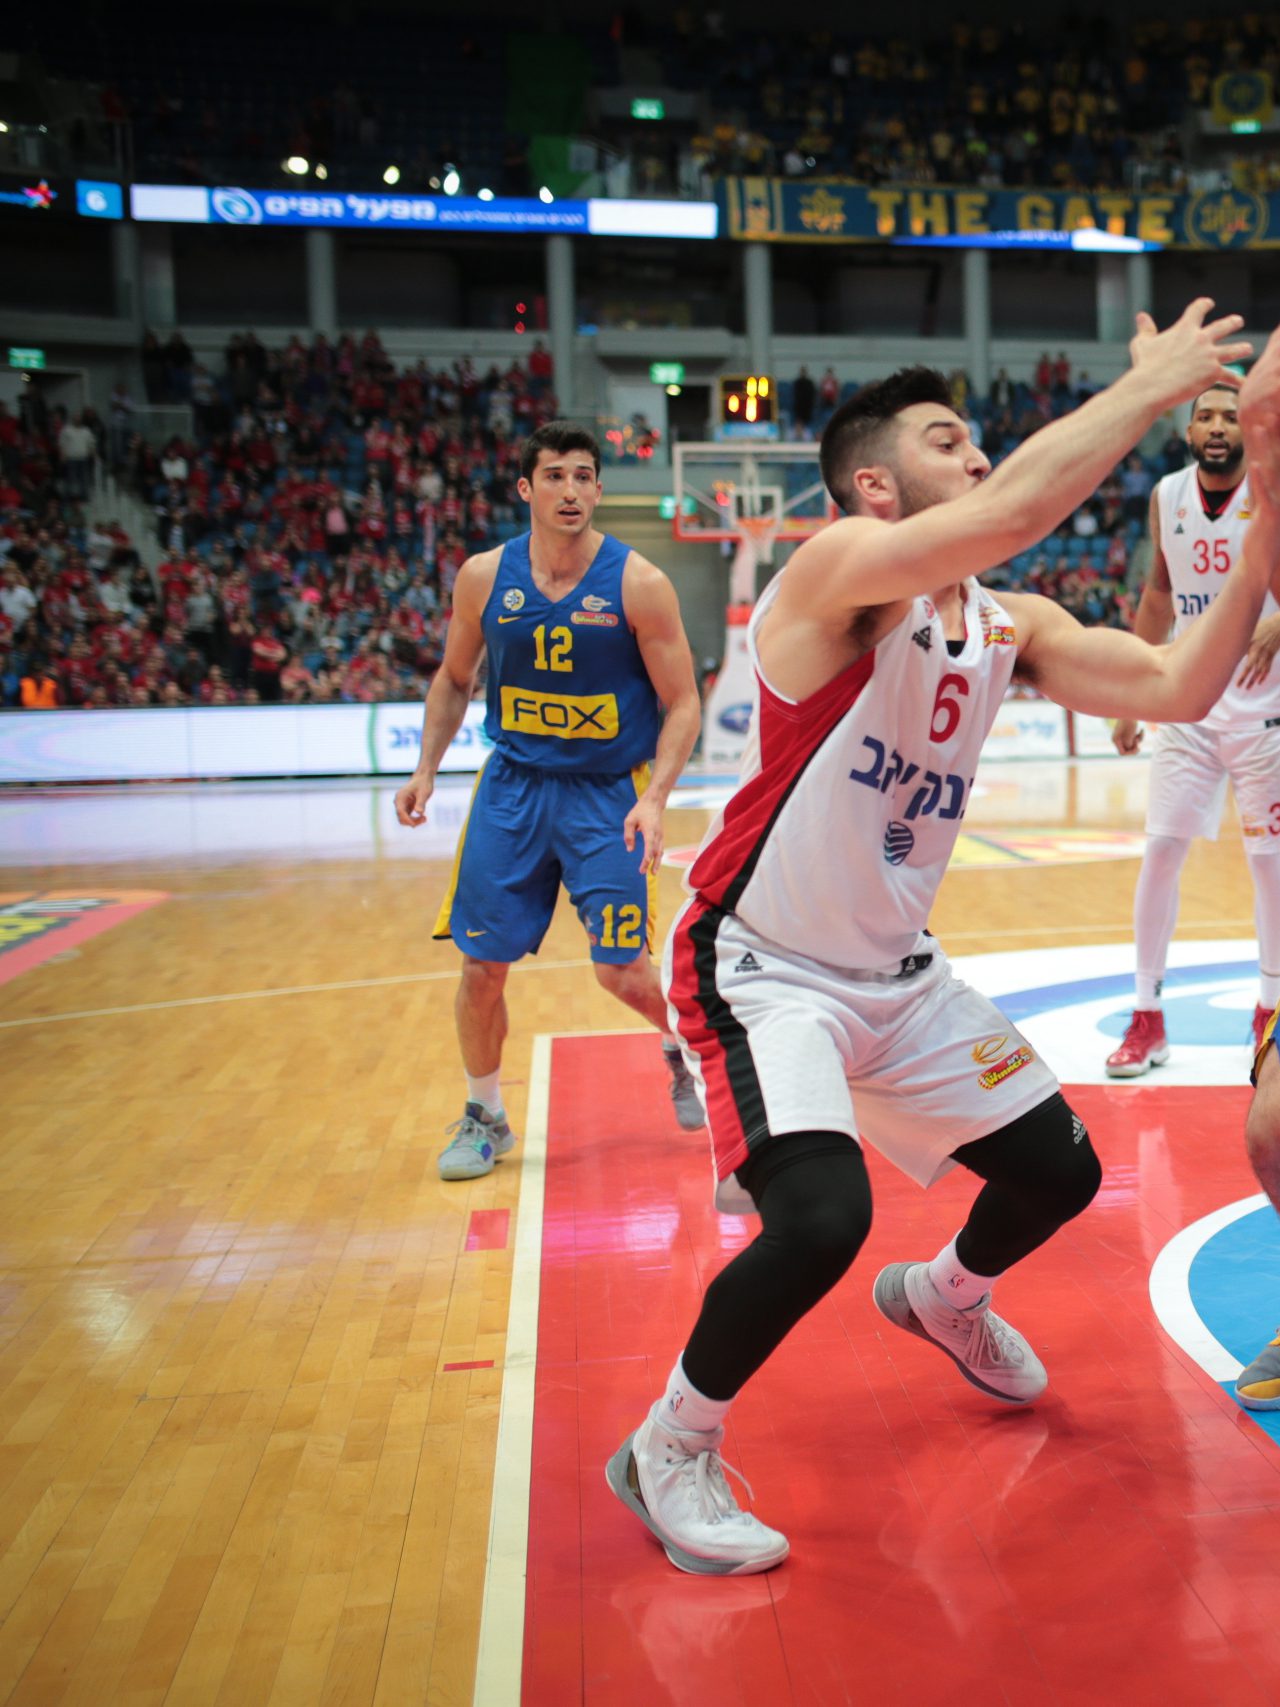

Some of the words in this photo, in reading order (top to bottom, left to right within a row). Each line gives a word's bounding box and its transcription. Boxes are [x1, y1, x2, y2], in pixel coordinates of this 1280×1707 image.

[85, 190, 108, 212] 6
[868, 189, 989, 236] THE
[1016, 196, 1174, 242] GATE
[1192, 539, 1231, 574] 35
[532, 624, 573, 673] 12
[513, 697, 607, 731] FOX
[929, 673, 970, 744] 6
[904, 770, 974, 820] נק
[600, 903, 641, 948] 12
